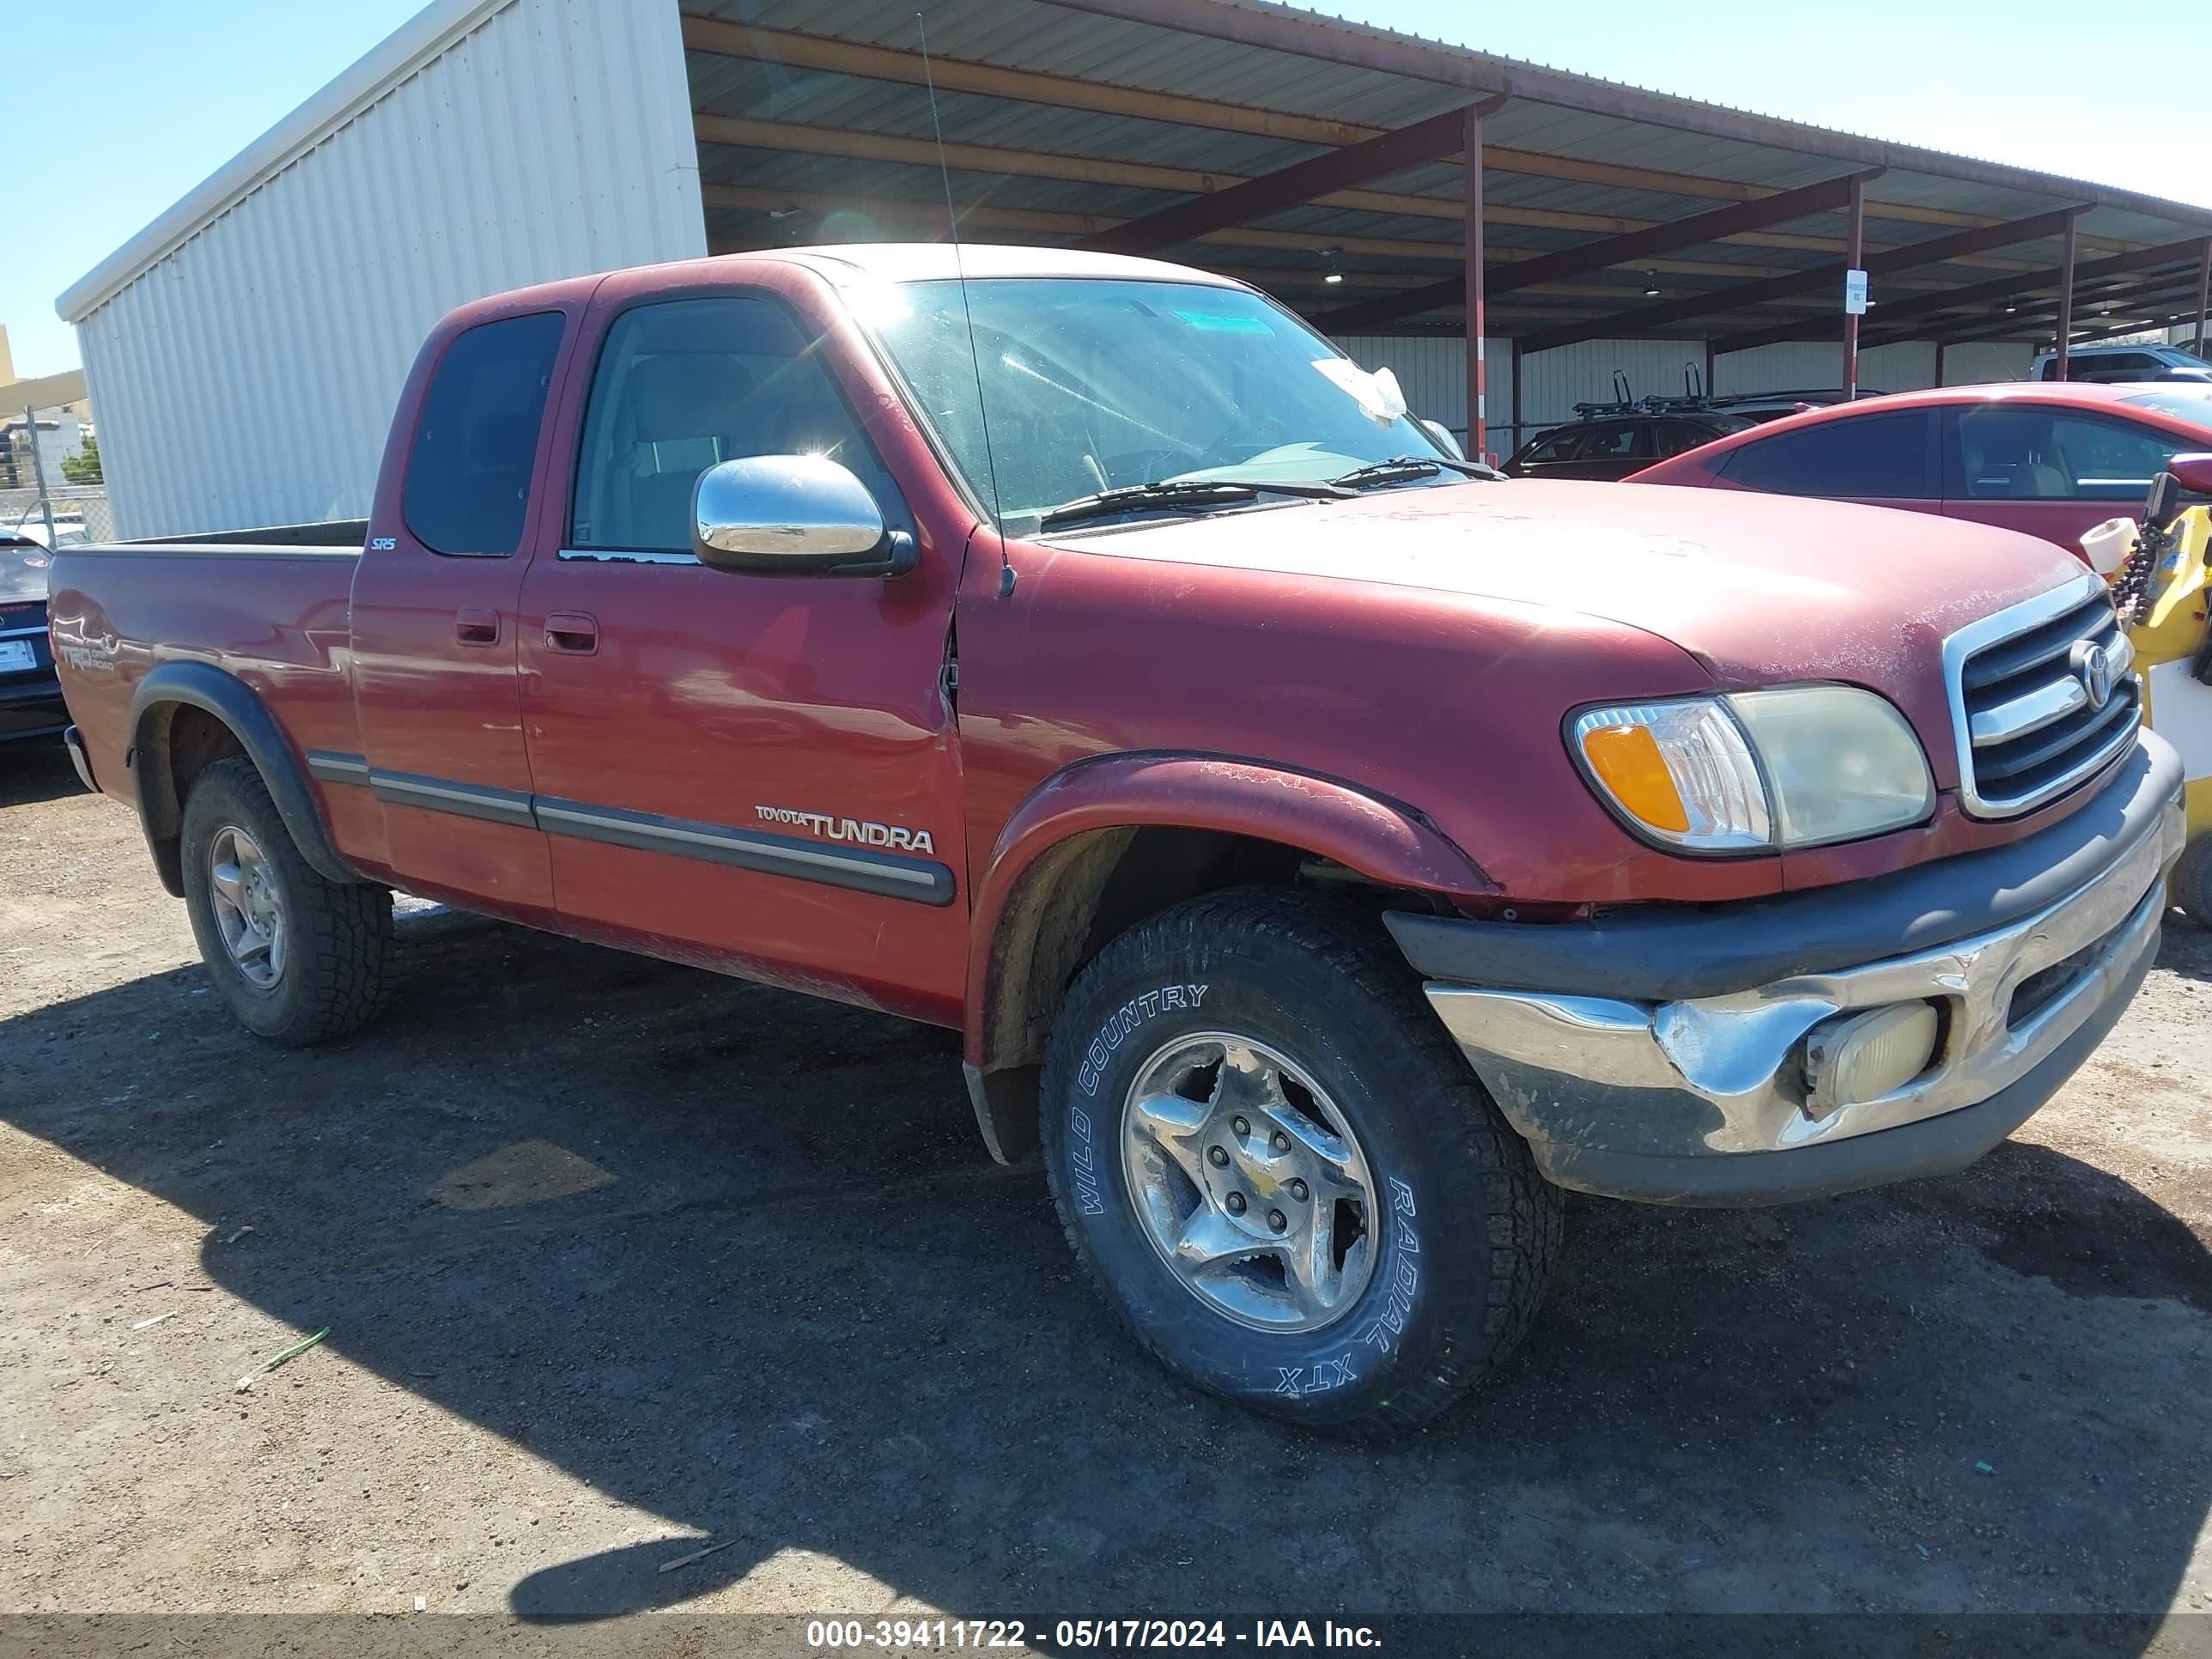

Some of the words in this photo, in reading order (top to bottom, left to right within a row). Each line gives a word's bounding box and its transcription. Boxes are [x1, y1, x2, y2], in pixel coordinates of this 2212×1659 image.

[370, 538, 397, 550] SR5
[58, 645, 92, 671] TRD
[755, 805, 808, 826] TOYOTA
[804, 813, 935, 854] TUNDRA
[1078, 984, 1209, 1097] COUNTRY
[1071, 1106, 1104, 1216] WILD
[1365, 1176, 1420, 1354] RADIAL
[1274, 1352, 1358, 1394] XTX
